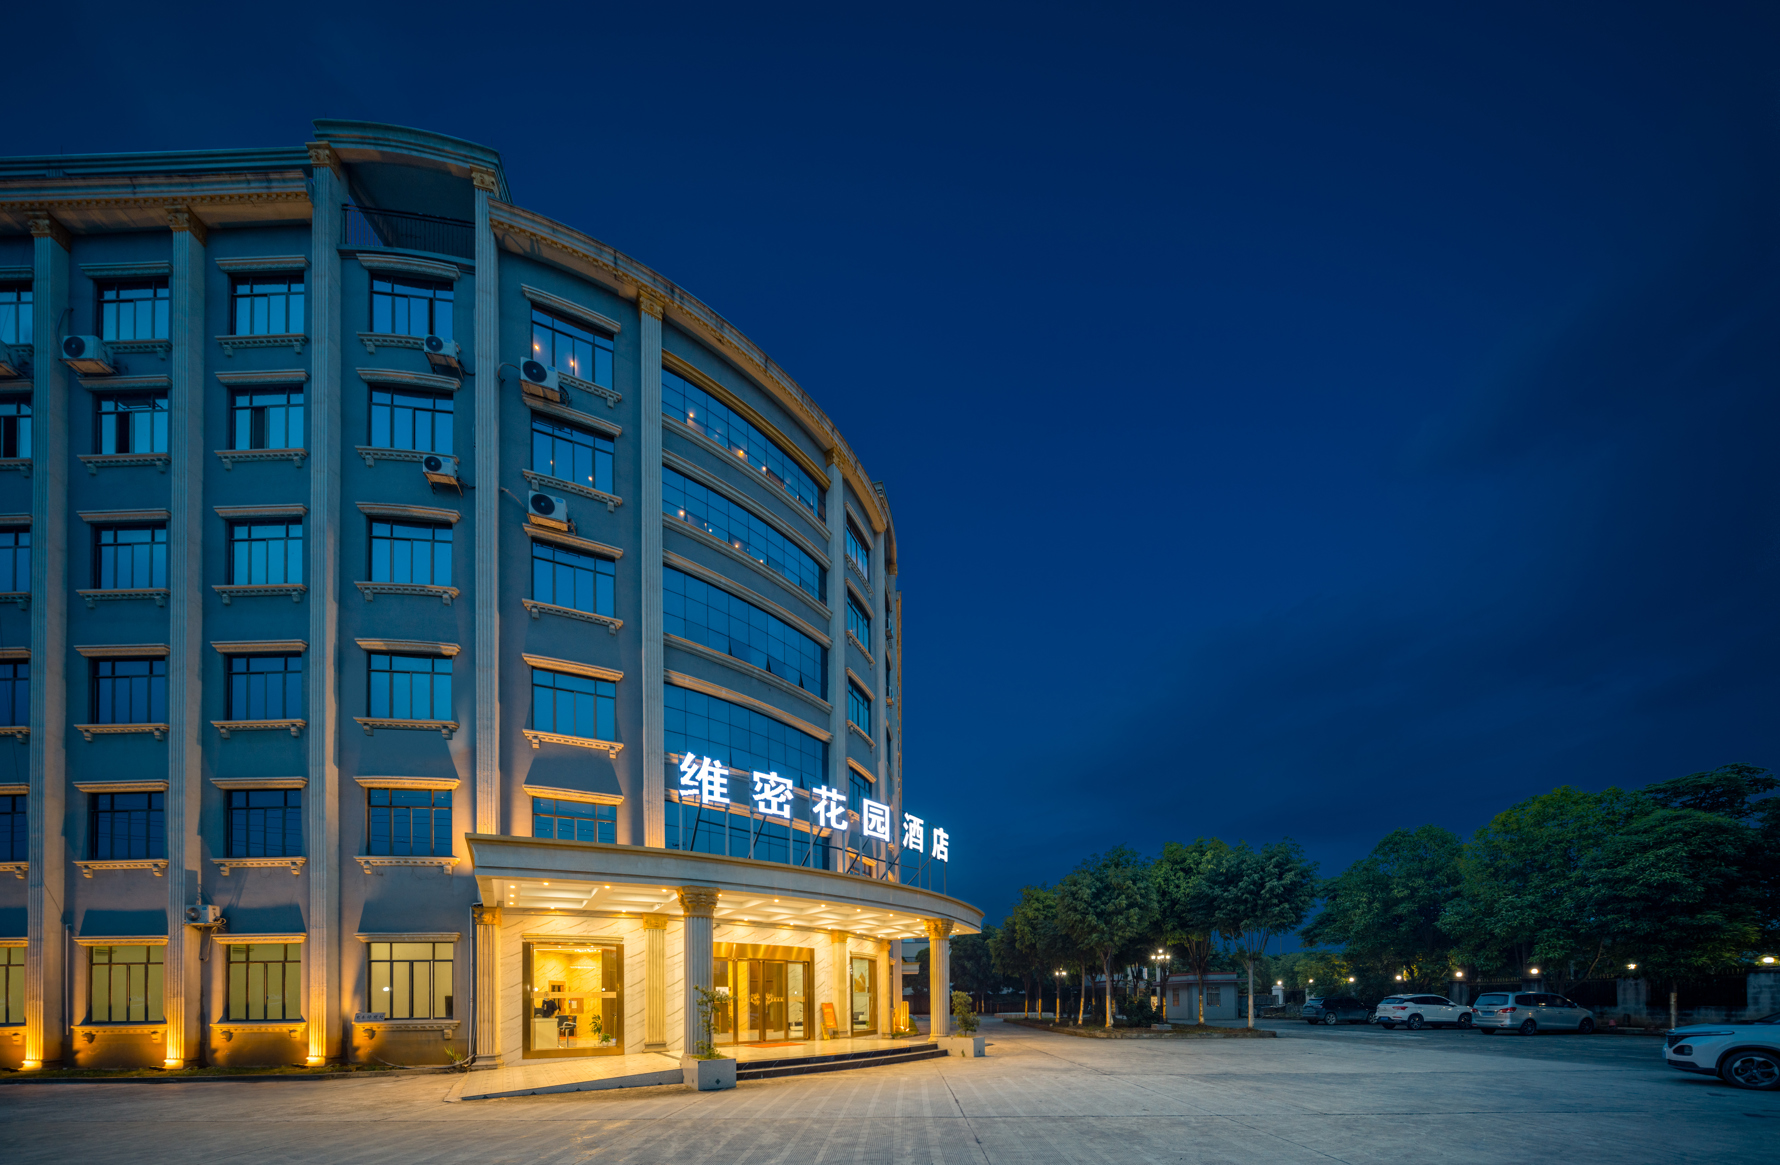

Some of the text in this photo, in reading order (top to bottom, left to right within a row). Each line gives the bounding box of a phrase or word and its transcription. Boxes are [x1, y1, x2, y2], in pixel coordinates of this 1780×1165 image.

[679, 751, 949, 863] 维密花园酒店
